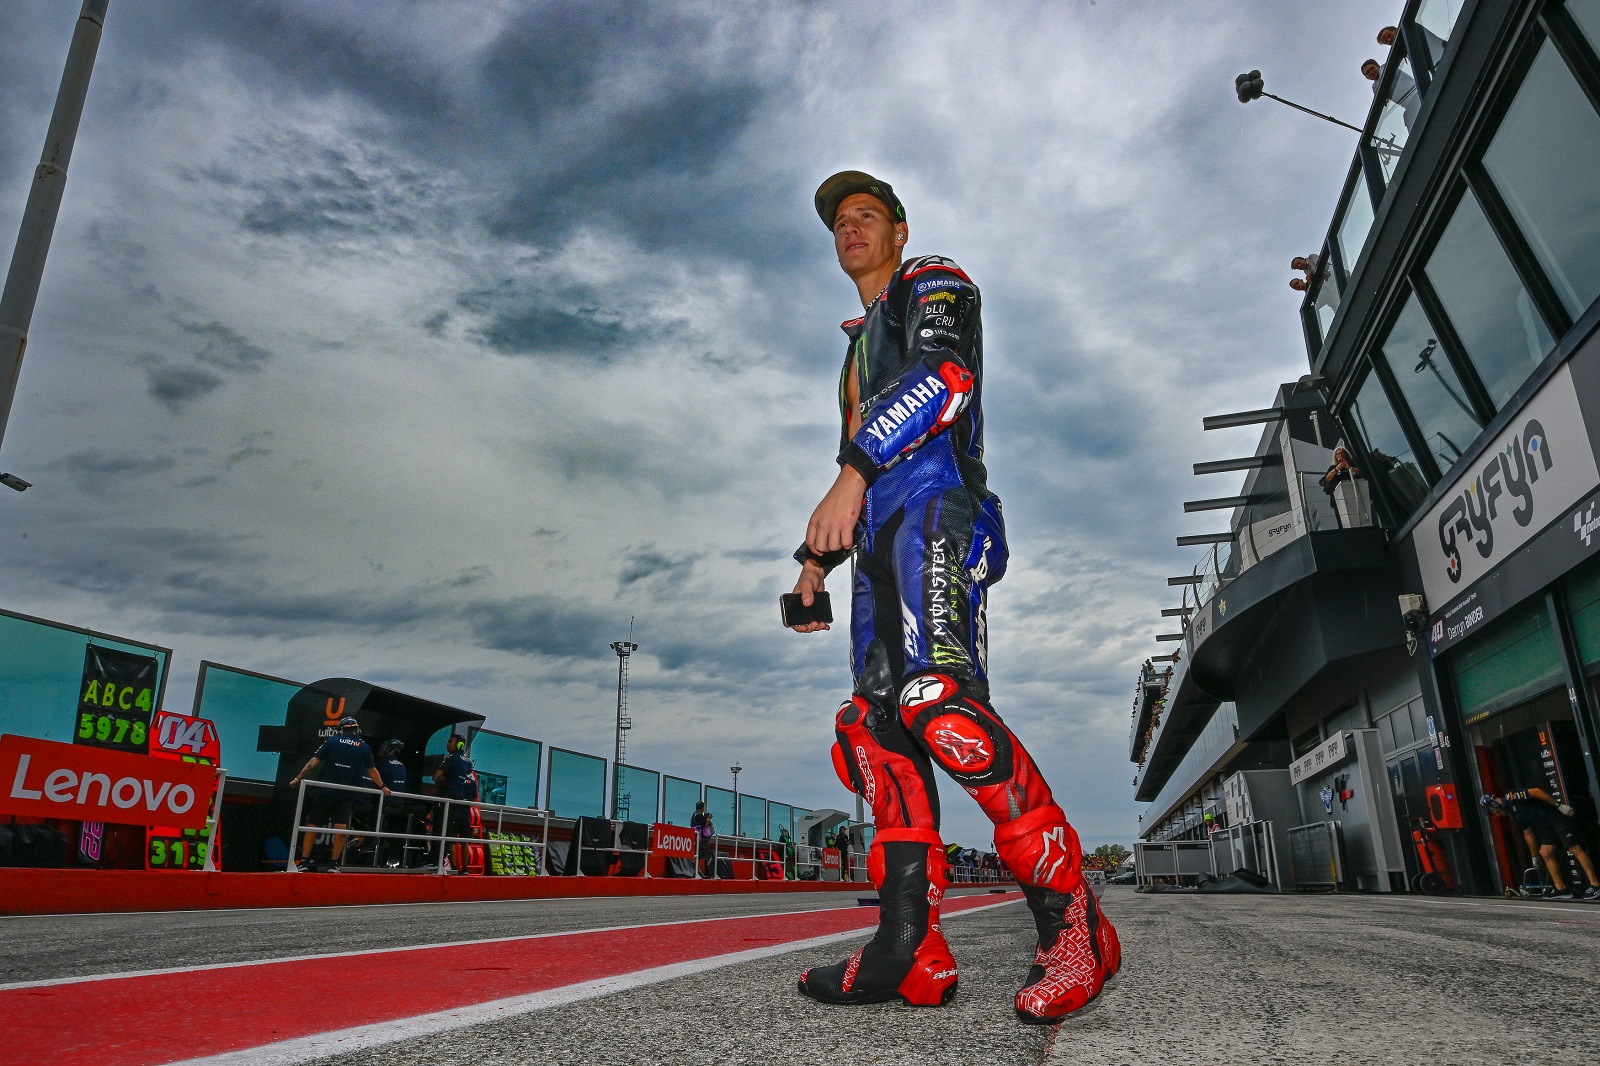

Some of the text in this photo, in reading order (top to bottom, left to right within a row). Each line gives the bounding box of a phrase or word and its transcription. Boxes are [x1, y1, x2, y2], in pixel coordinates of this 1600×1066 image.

[927, 280, 960, 289] YAMAHA
[866, 375, 947, 442] YAMAHA
[929, 537, 949, 636] MONSTER
[948, 553, 958, 621] ENERGY
[78, 713, 146, 745] 5978
[158, 715, 207, 754] 04
[10, 753, 195, 814] Lenovo
[657, 829, 692, 852] Lenovo
